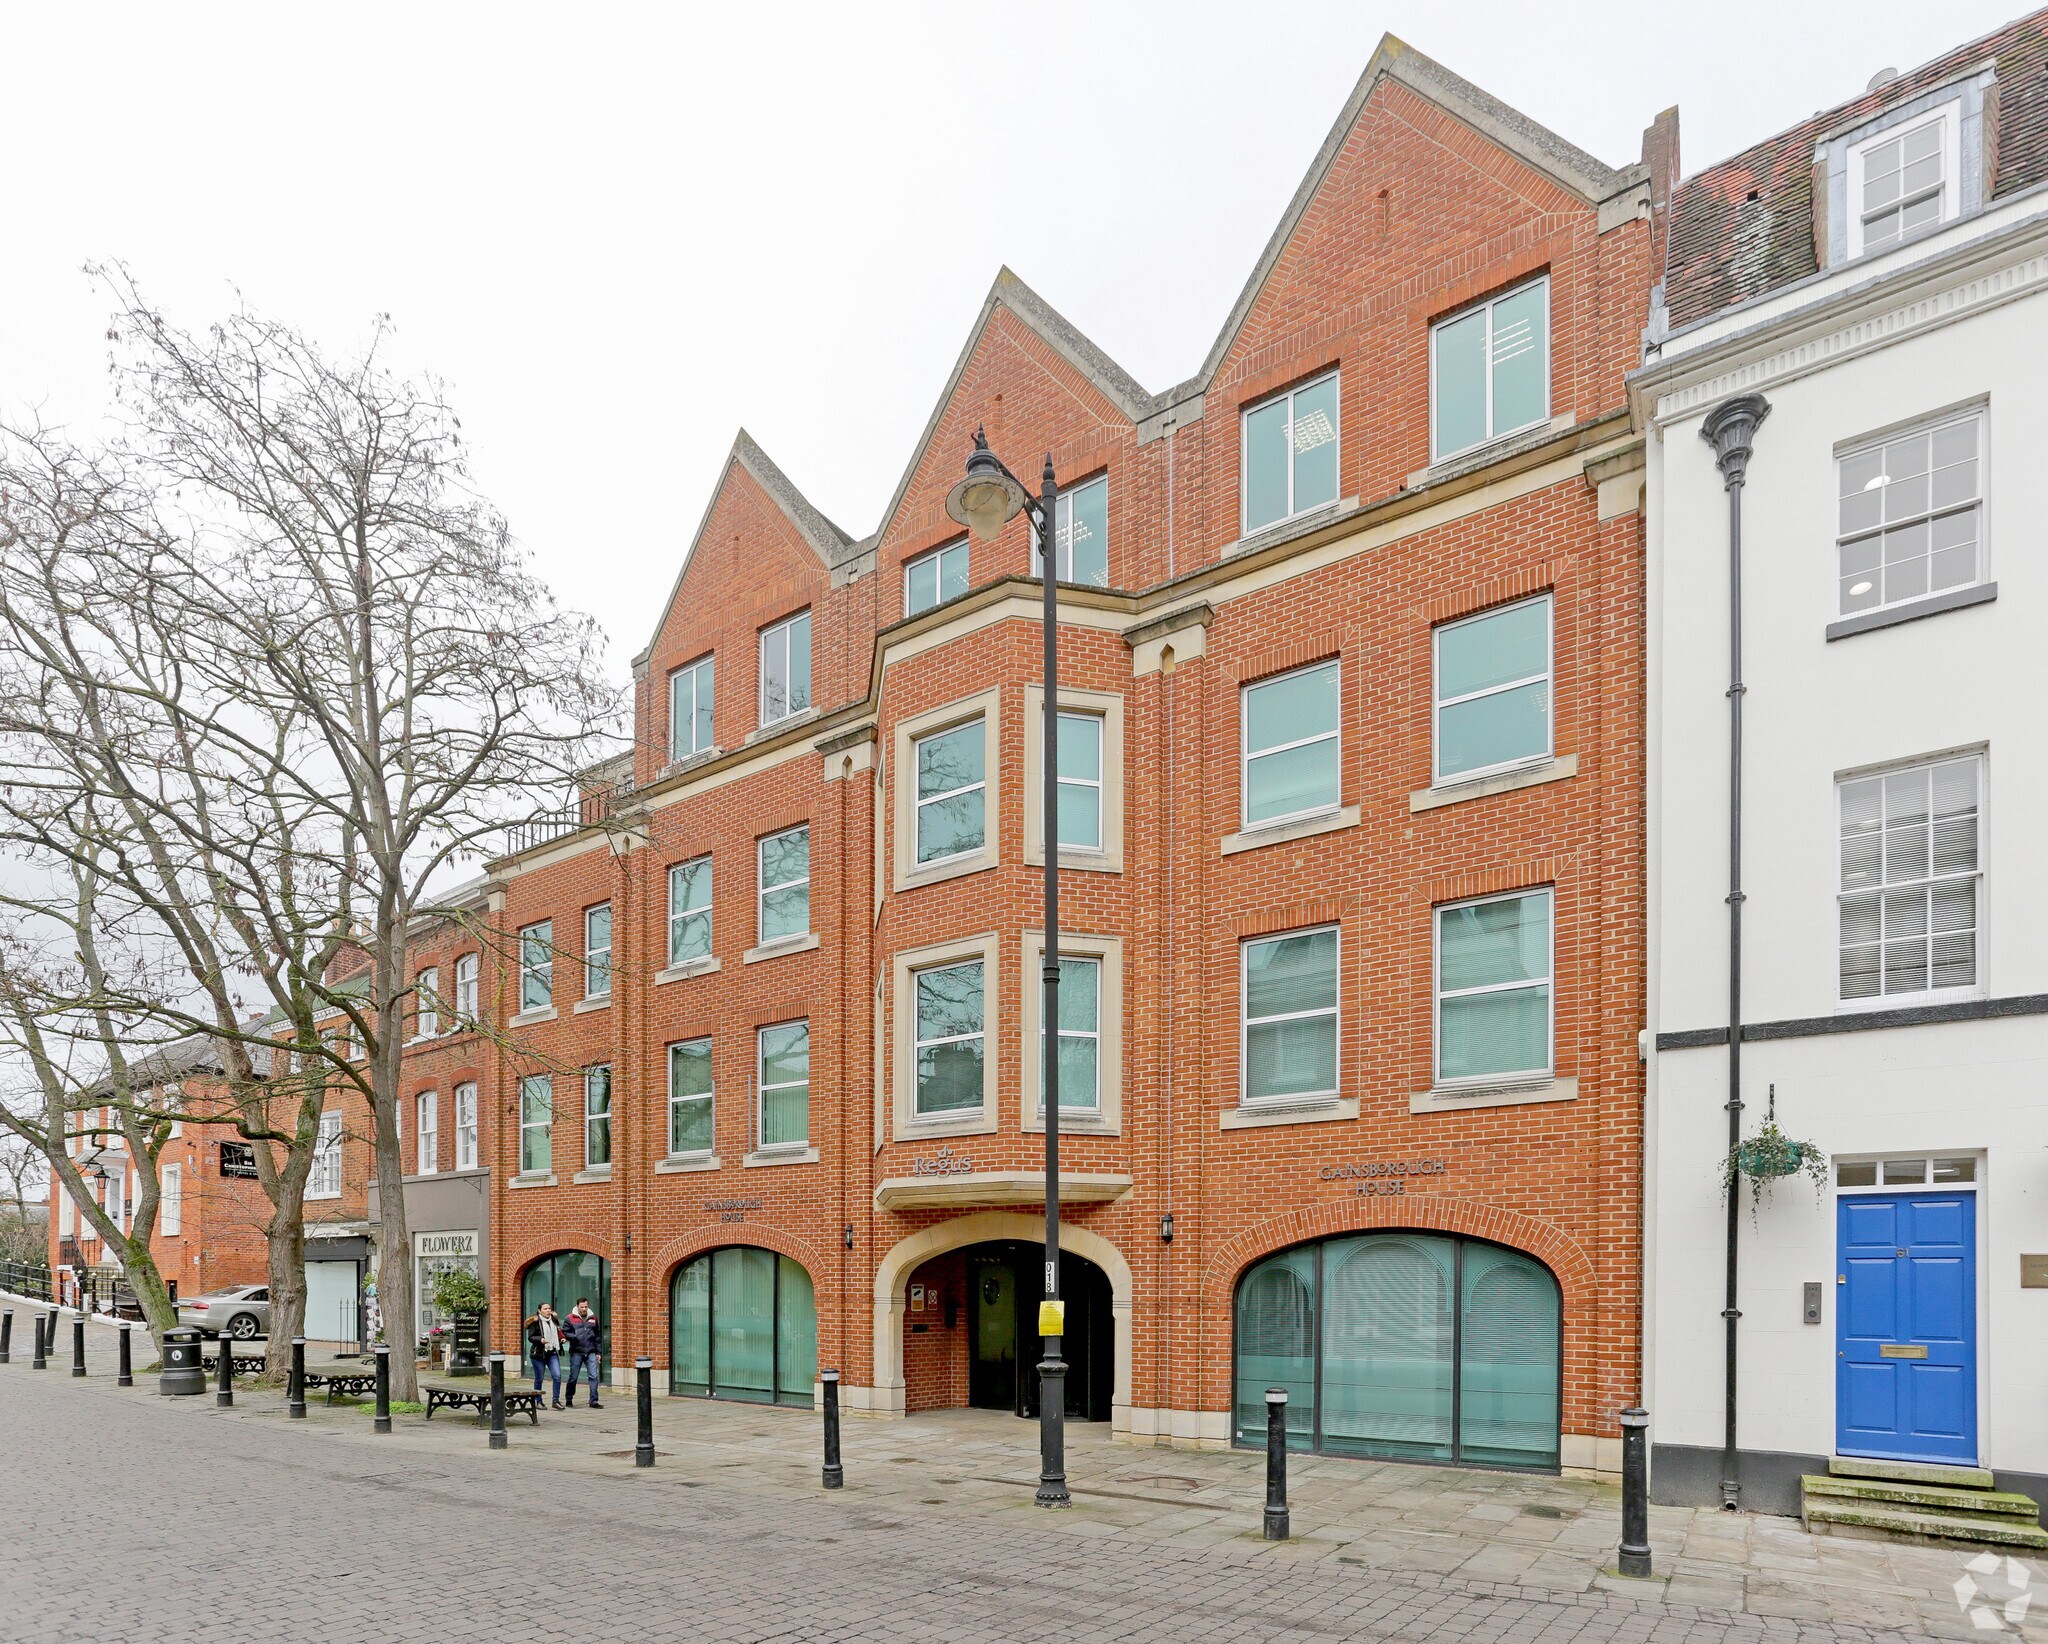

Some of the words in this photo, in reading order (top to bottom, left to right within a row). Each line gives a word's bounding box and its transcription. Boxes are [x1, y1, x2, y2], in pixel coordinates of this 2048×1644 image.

[914, 1157, 972, 1178] Regus
[1319, 1159, 1445, 1180] GAINSBOROUGH
[1356, 1180, 1405, 1197] HOUSE
[704, 1199, 762, 1211] GAINSBOROUGH
[721, 1212, 745, 1223] HOUSE
[422, 1236, 472, 1252] FLOWERZ
[1896, 1247, 1909, 1258] 61
